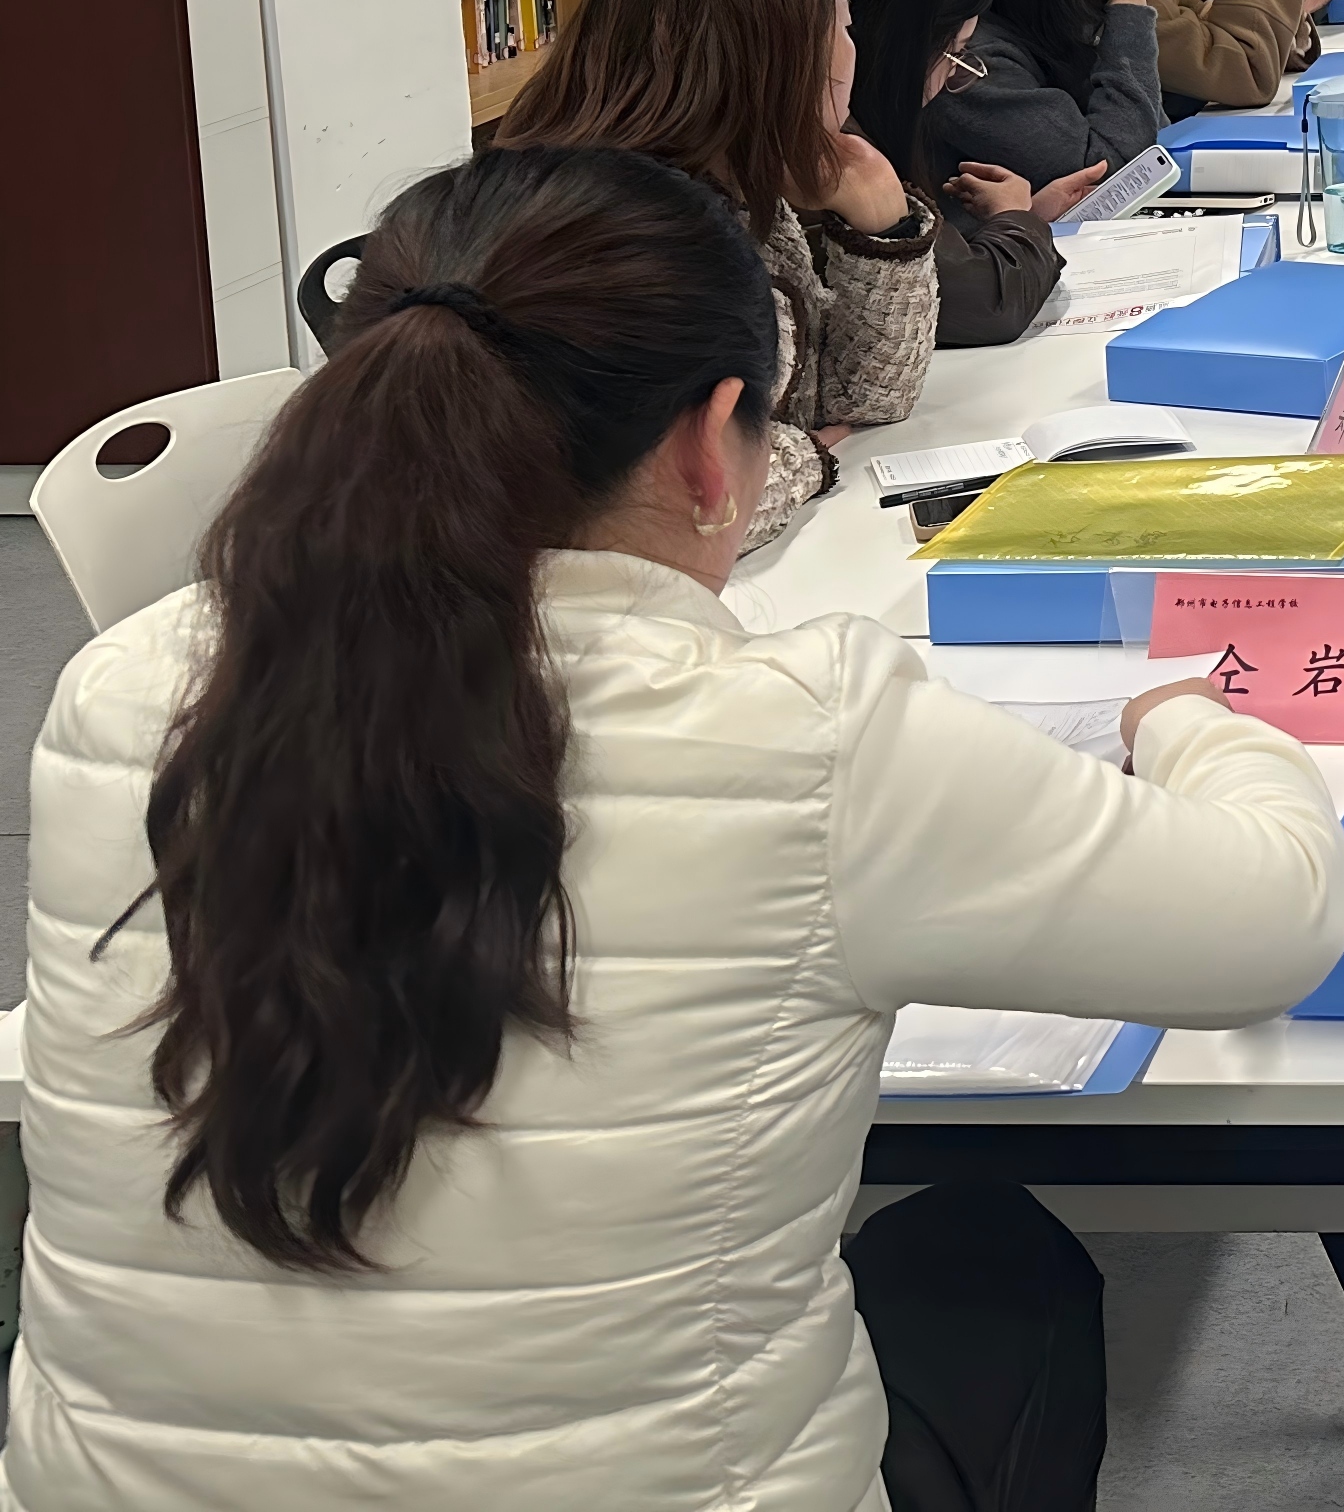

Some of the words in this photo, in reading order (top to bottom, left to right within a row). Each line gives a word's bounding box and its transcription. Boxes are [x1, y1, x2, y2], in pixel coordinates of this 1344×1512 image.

[1174, 597, 1299, 609] 郑州市电子信息工程学校
